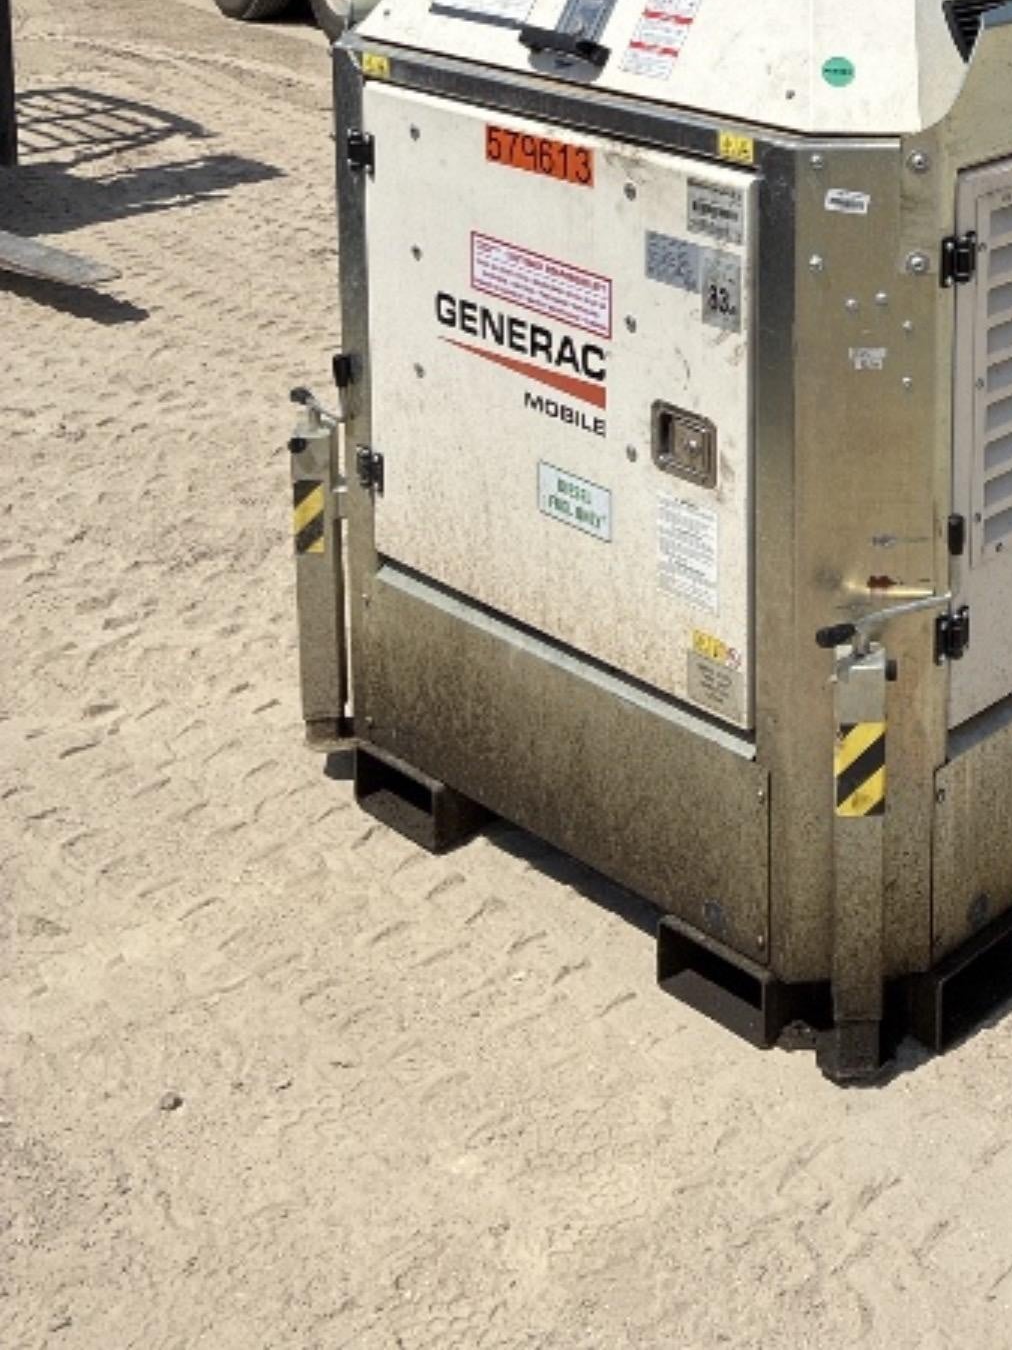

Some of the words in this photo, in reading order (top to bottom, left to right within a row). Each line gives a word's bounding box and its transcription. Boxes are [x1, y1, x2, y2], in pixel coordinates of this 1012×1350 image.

[486, 125, 592, 184] 579613
[435, 291, 607, 382] GENERAC
[523, 391, 607, 438] MOBILE
